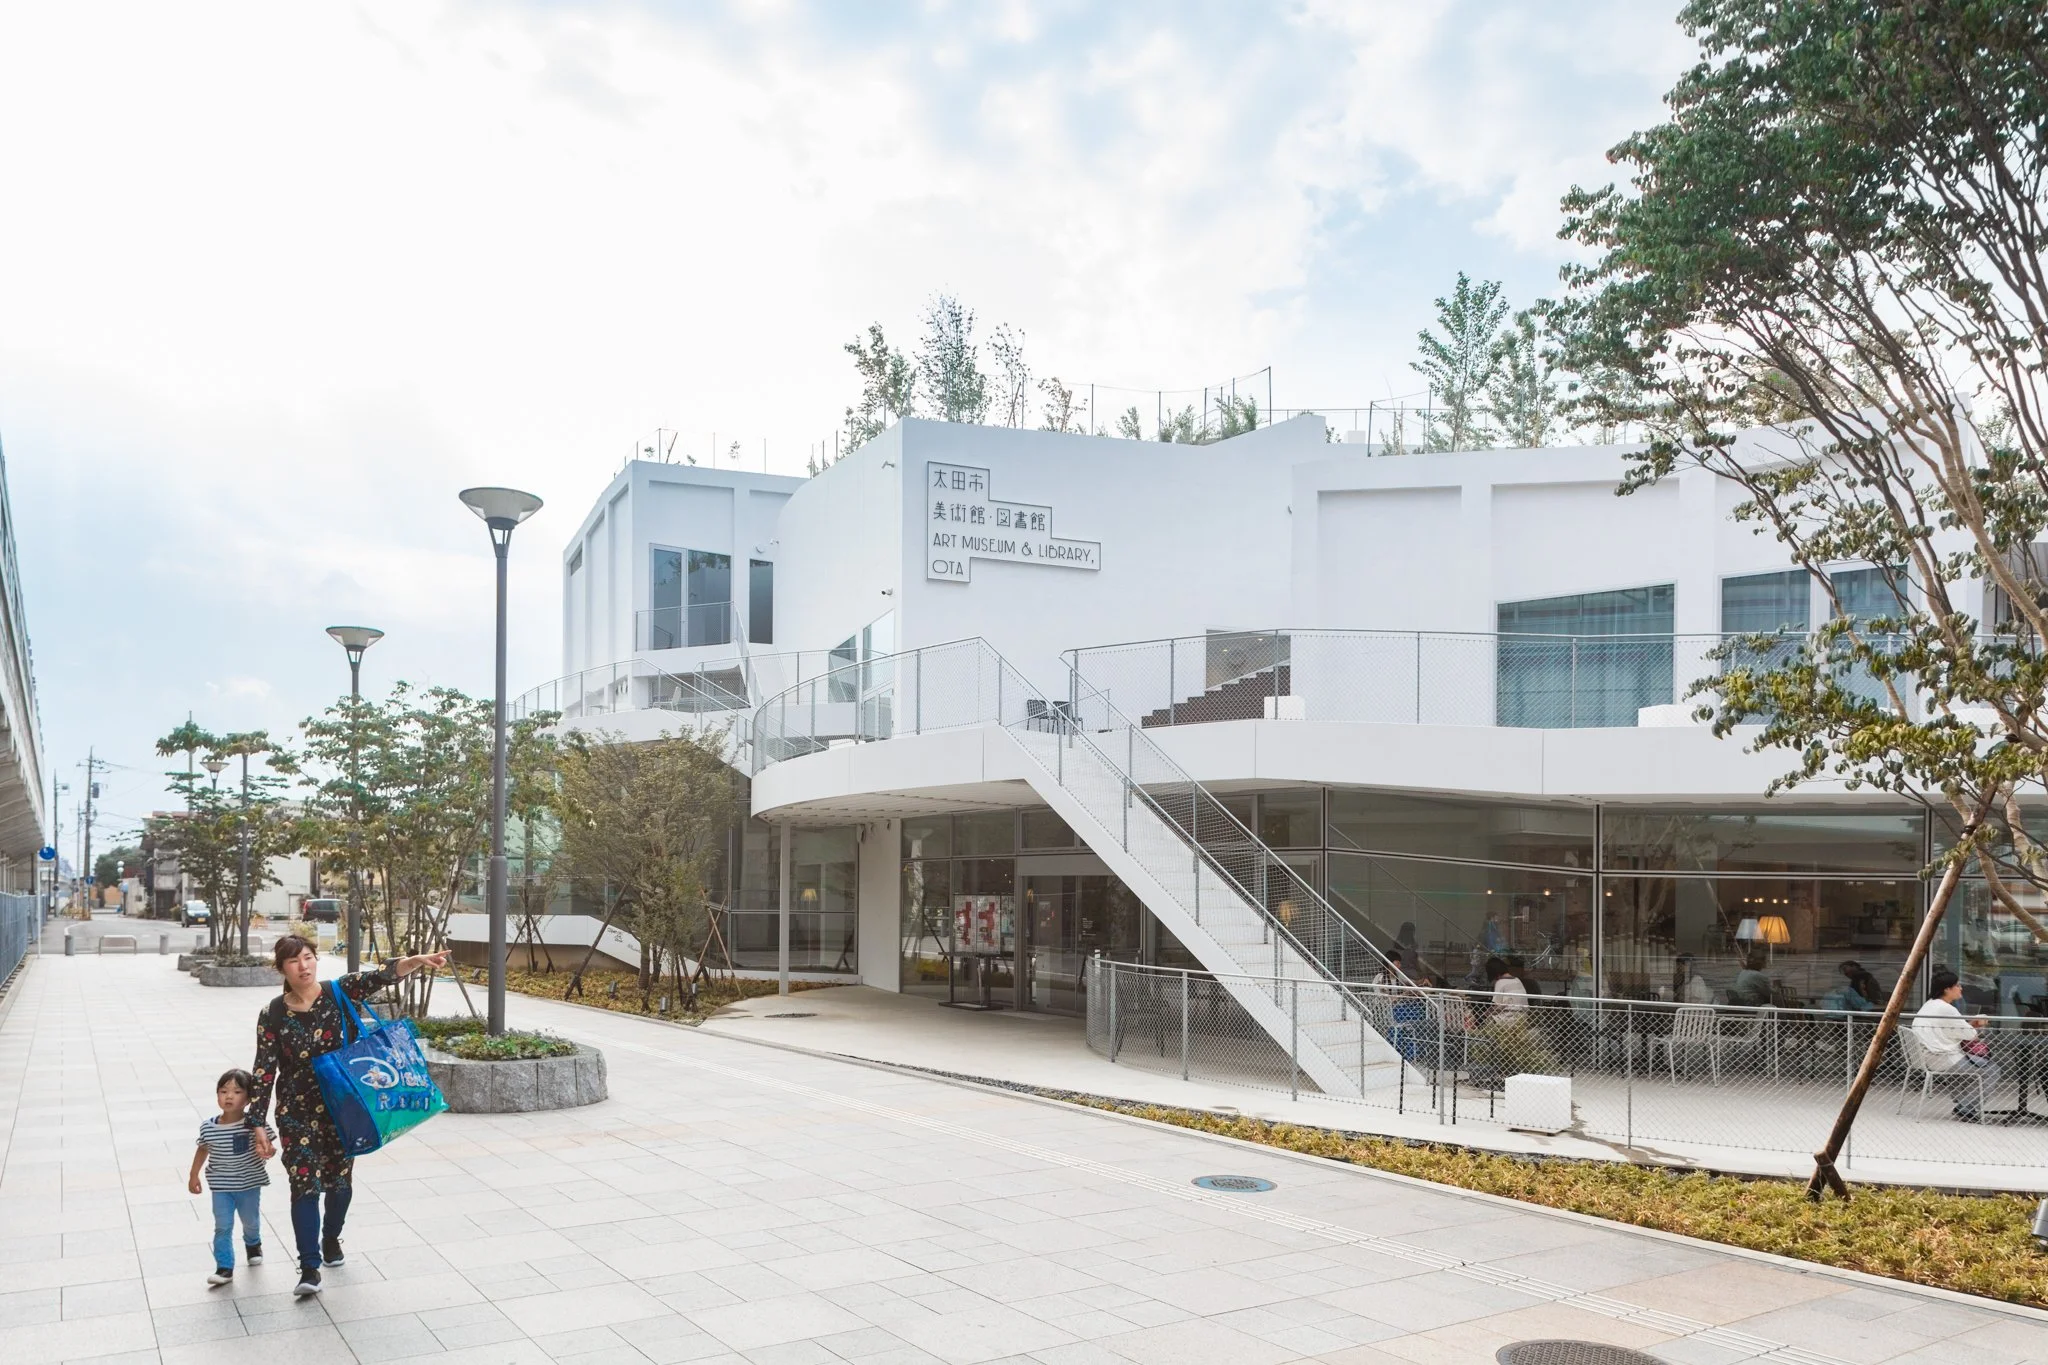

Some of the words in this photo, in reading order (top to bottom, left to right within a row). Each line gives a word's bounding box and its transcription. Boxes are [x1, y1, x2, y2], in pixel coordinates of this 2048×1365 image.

[933, 468, 984, 493] 太田市
[932, 532, 957, 549] ART
[962, 535, 1016, 555] MUSEUM
[1021, 541, 1033, 556] &
[1039, 543, 1095, 564] LIBRARY,
[932, 559, 964, 576] OTA
